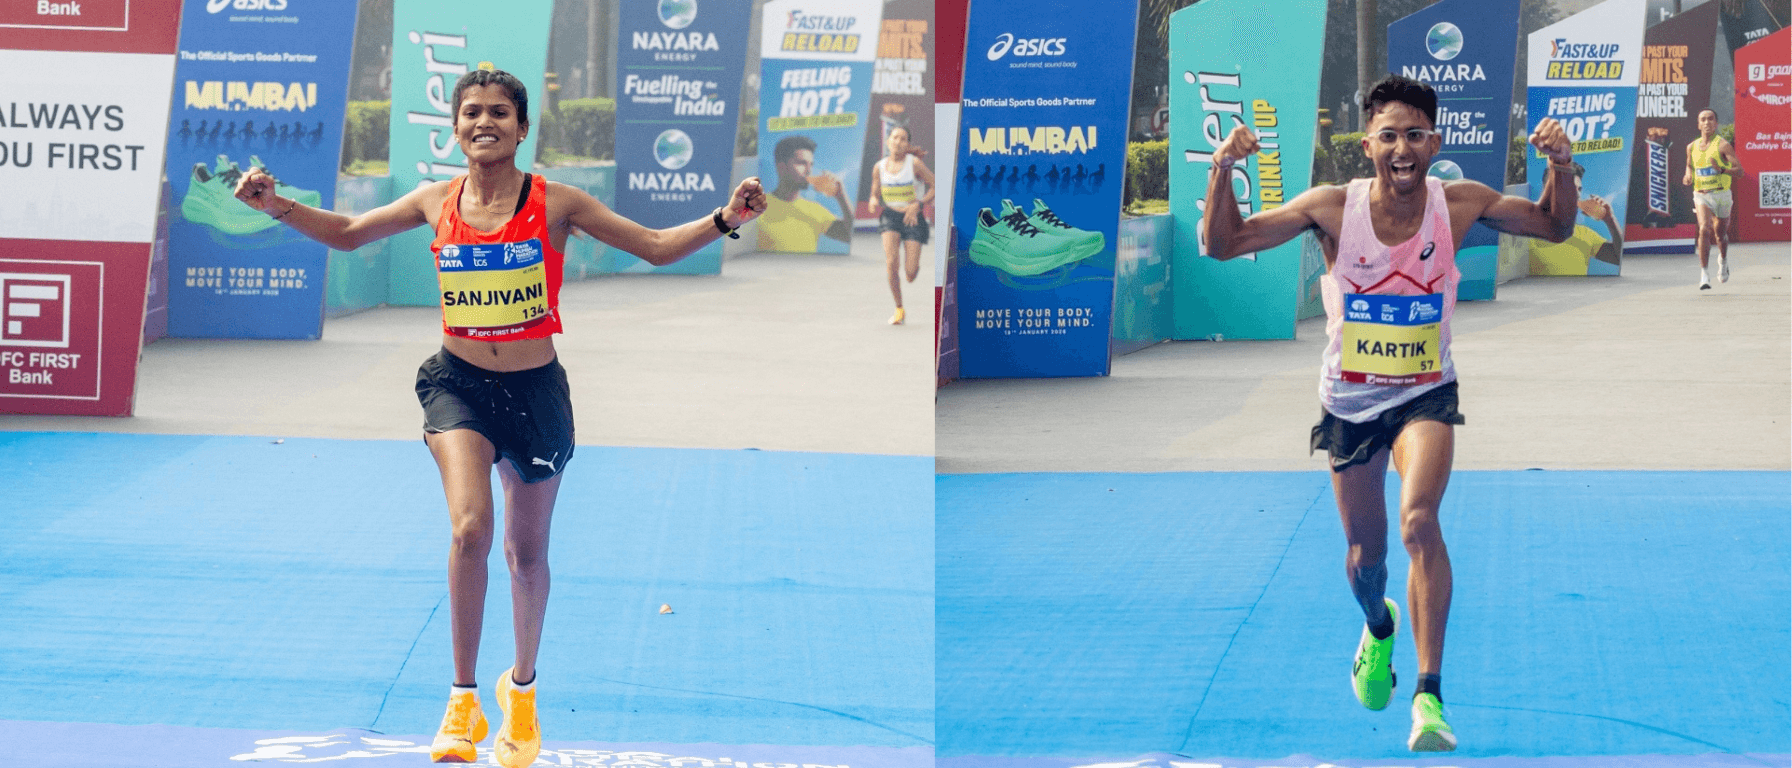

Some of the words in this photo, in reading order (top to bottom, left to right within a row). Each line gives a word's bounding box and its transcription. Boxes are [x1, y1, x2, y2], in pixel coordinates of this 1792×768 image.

[37, 0, 81, 16] Bank
[791, 10, 857, 30] FAST&UP
[632, 31, 719, 51] NAYARA
[783, 33, 860, 52] RELOAD
[1744, 27, 1770, 40] TATA
[1013, 37, 1067, 56] asics
[1555, 38, 1620, 59] FAST&UP
[180, 51, 196, 60] The
[197, 51, 228, 61] Official
[228, 52, 254, 63] Sports
[256, 52, 282, 62] Goods
[654, 53, 697, 61] ENERGY
[780, 66, 852, 89] FEELING
[1402, 64, 1487, 82] NAYARA
[1547, 61, 1622, 79] RELOAD
[1640, 58, 1688, 83] MITS.
[624, 74, 703, 99] Fuelling
[872, 73, 926, 95] UNGER.
[1430, 84, 1465, 92] NERGY
[1667, 84, 1688, 95] YOUR
[185, 81, 318, 112] MUMBAI
[674, 94, 725, 116] India
[779, 86, 852, 118] HOT?
[963, 98, 978, 107] The
[980, 98, 1007, 107] Official
[1009, 98, 1035, 109] Sports
[1036, 97, 1062, 107] Goods
[1548, 92, 1616, 116] FEELING
[0, 102, 124, 131] LWAYS
[408, 30, 469, 188] isleri
[1435, 107, 1472, 129] ling
[1474, 111, 1486, 119] the
[969, 126, 1097, 156] MUMBAI
[1444, 125, 1494, 145] India
[1577, 141, 1587, 152] TO
[1588, 138, 1621, 151] RELOAD!
[48, 142, 145, 171] FIRST
[628, 172, 715, 191] NAYARA
[1650, 143, 1668, 212] SNICKERS
[650, 193, 693, 201] ENERGY
[439, 259, 463, 267] TATA
[186, 267, 222, 277] MOVE
[229, 267, 264, 277] YOUR
[270, 268, 307, 280] BODY,
[186, 278, 221, 288] MOVE
[228, 279, 263, 288] YOUR
[269, 279, 308, 289] MIND.
[443, 282, 543, 306] SANJIVANI
[522, 303, 545, 319] 134
[976, 309, 1011, 319] MOVE
[1018, 308, 1051, 318] YOUR
[1058, 308, 1093, 318] BODY,
[1348, 311, 1371, 320] TATA
[492, 328, 509, 336] FIRST
[976, 319, 1011, 329] MOVE
[1017, 318, 1051, 328] YOUR
[1057, 318, 1095, 328] MIND.
[1019, 328, 1049, 336] JANUARY
[1356, 339, 1427, 358] KARTIK
[0, 351, 24, 367] FC
[29, 352, 81, 369] FIRST
[1420, 360, 1434, 371] 57
[9, 368, 53, 384] Bank
